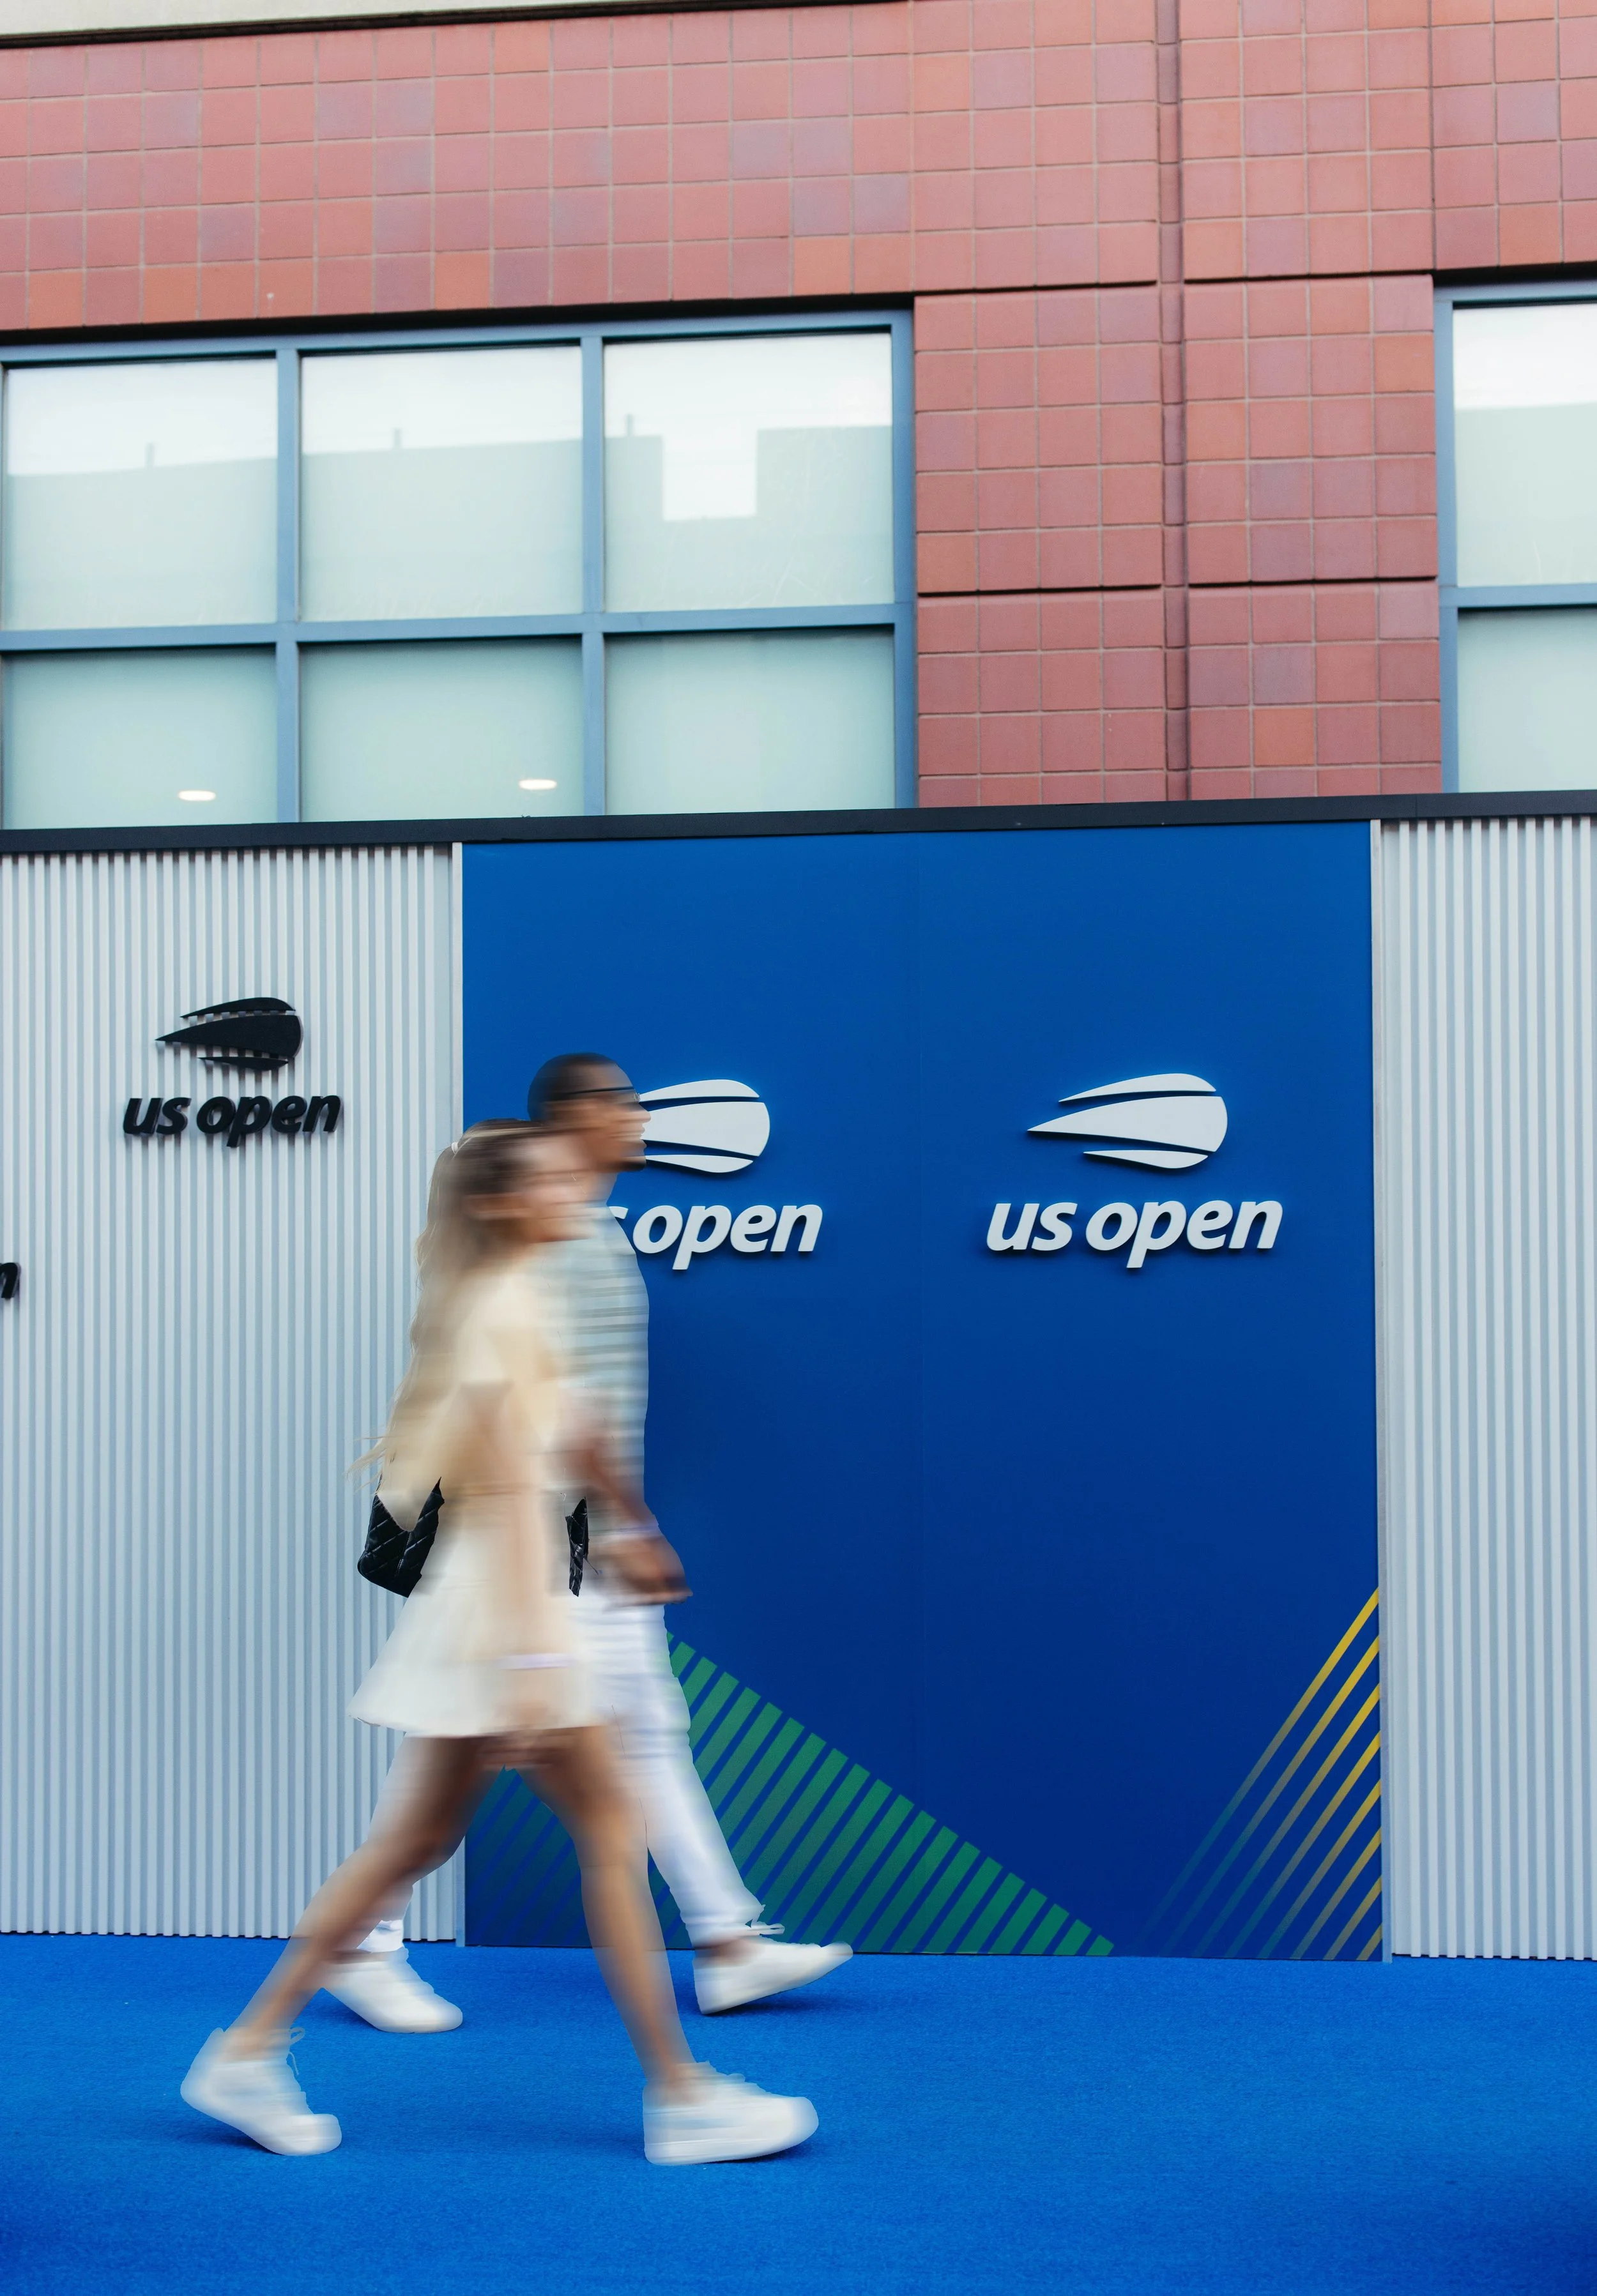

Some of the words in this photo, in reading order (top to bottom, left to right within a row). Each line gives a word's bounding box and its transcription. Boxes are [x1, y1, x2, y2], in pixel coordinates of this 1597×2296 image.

[123, 1097, 192, 1135] us
[196, 1095, 342, 1148] open
[632, 1204, 823, 1270] open
[986, 1201, 1078, 1251] us
[1085, 1200, 1283, 1268] open
